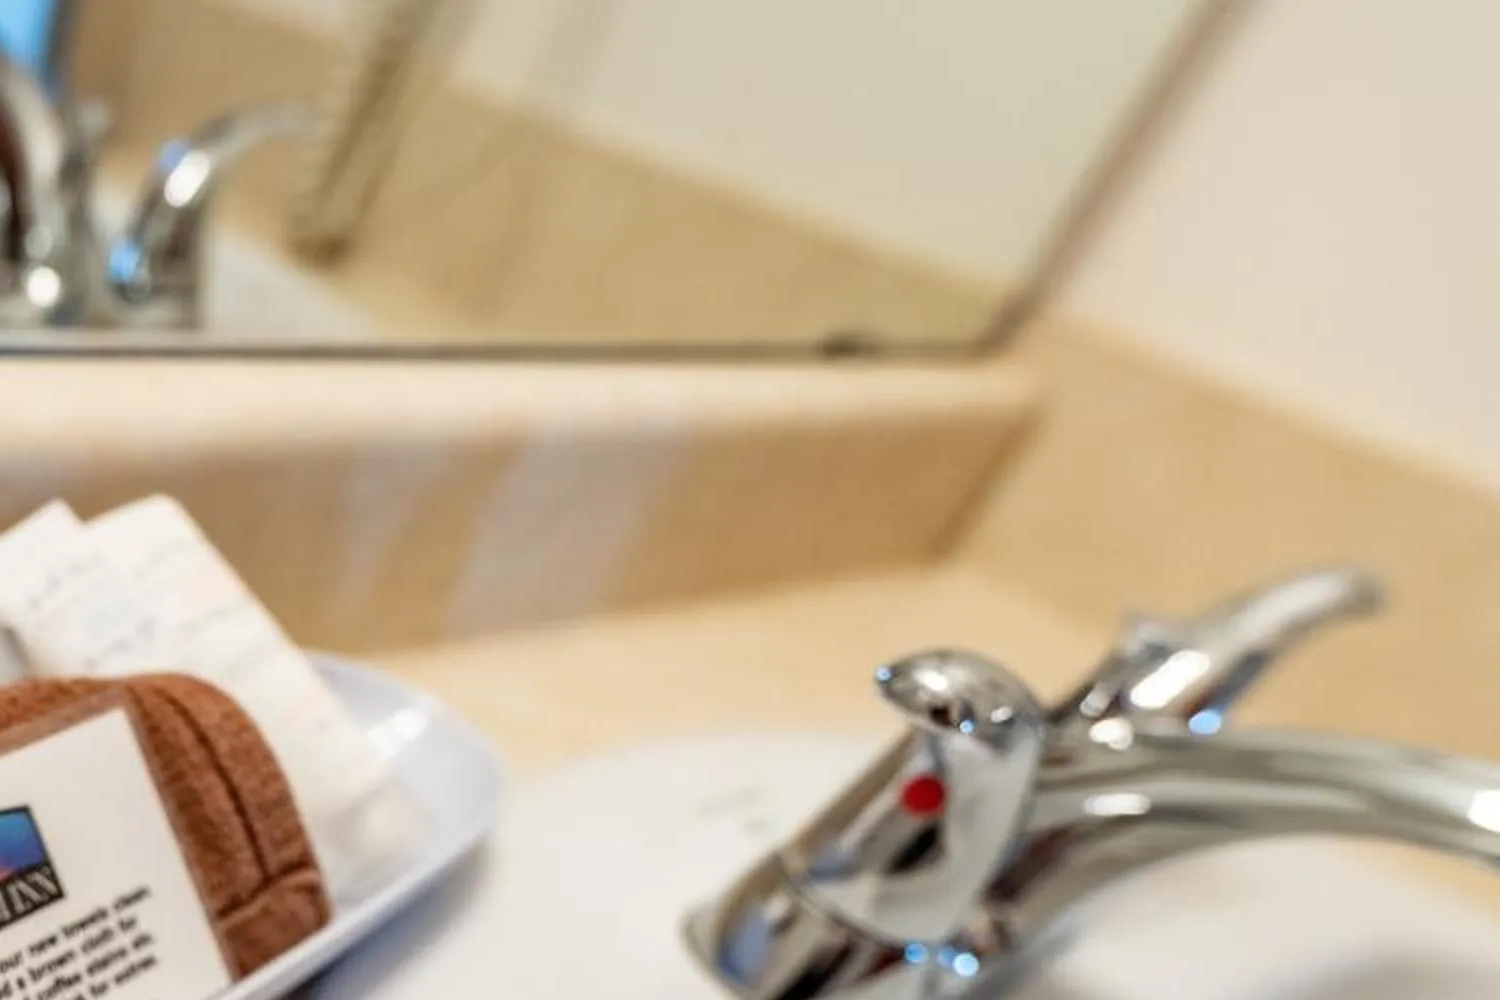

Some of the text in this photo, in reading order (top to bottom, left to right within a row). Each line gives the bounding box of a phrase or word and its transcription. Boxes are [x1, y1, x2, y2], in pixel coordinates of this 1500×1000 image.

[29, 935, 58, 954] new
[61, 907, 109, 938] towels
[16, 976, 26, 990] a
[28, 950, 76, 981] brown
[89, 981, 109, 998] for
